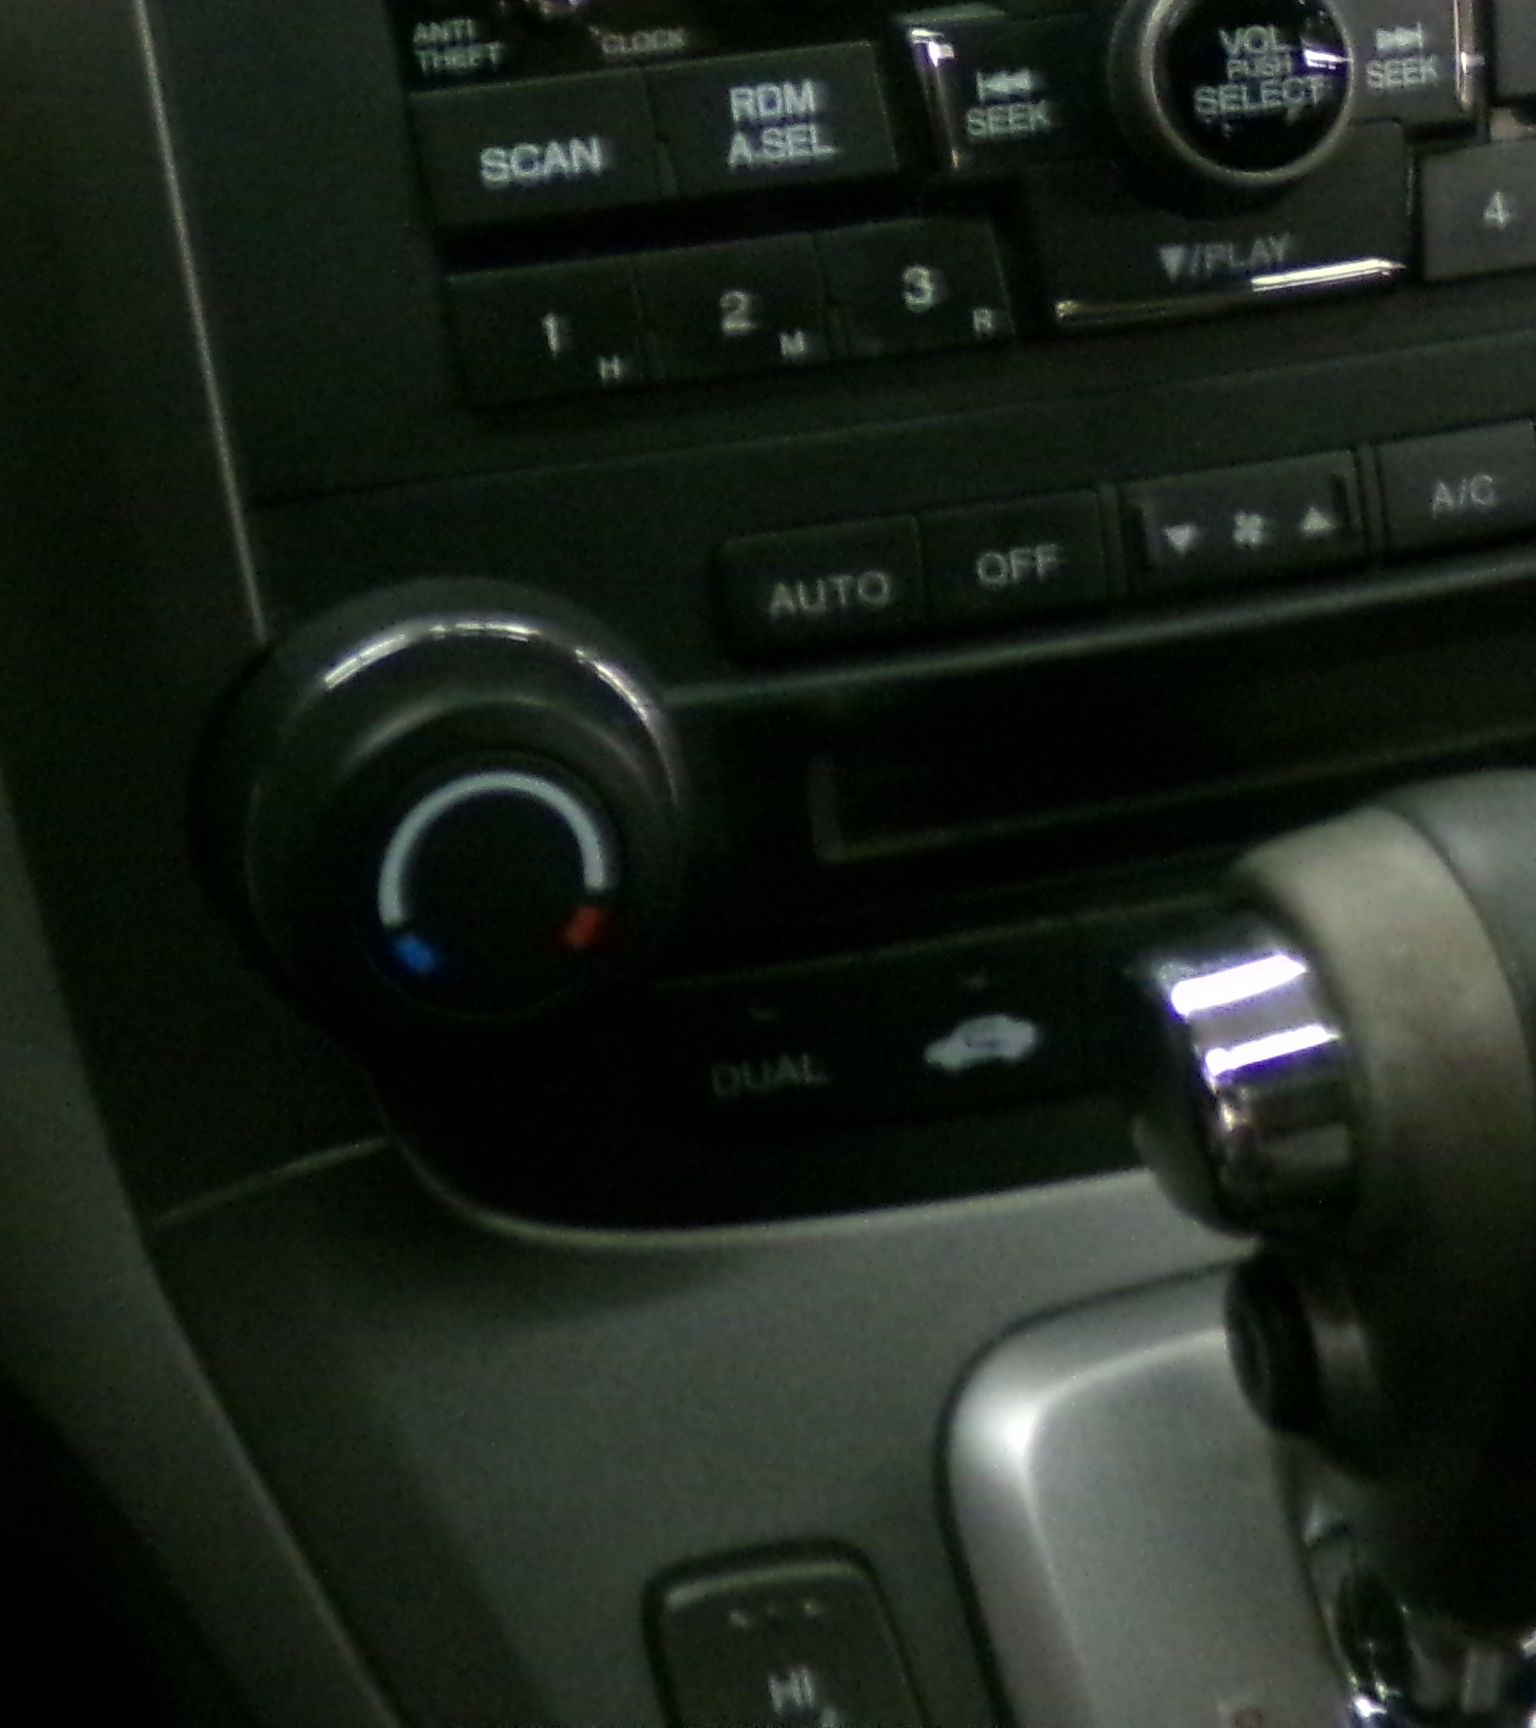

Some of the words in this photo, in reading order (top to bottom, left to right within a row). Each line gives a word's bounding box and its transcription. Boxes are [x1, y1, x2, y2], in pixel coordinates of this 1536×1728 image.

[601, 28, 686, 56] CLOCK
[1218, 25, 1292, 55] VOL
[1366, 56, 1440, 90] SEEK
[729, 78, 818, 123] RDM
[1195, 76, 1327, 115] SELECT
[966, 101, 1053, 138] SEEK
[479, 136, 604, 188] SCAN
[727, 125, 836, 169] A.SEL
[1483, 191, 1511, 231] 4
[902, 265, 936, 313] 3
[542, 313, 562, 356] 1
[719, 290, 755, 336] 2
[1428, 474, 1496, 514] A/C
[975, 543, 1062, 590] OFF
[767, 570, 894, 621] AUTO
[710, 1054, 829, 1100] DUAL
